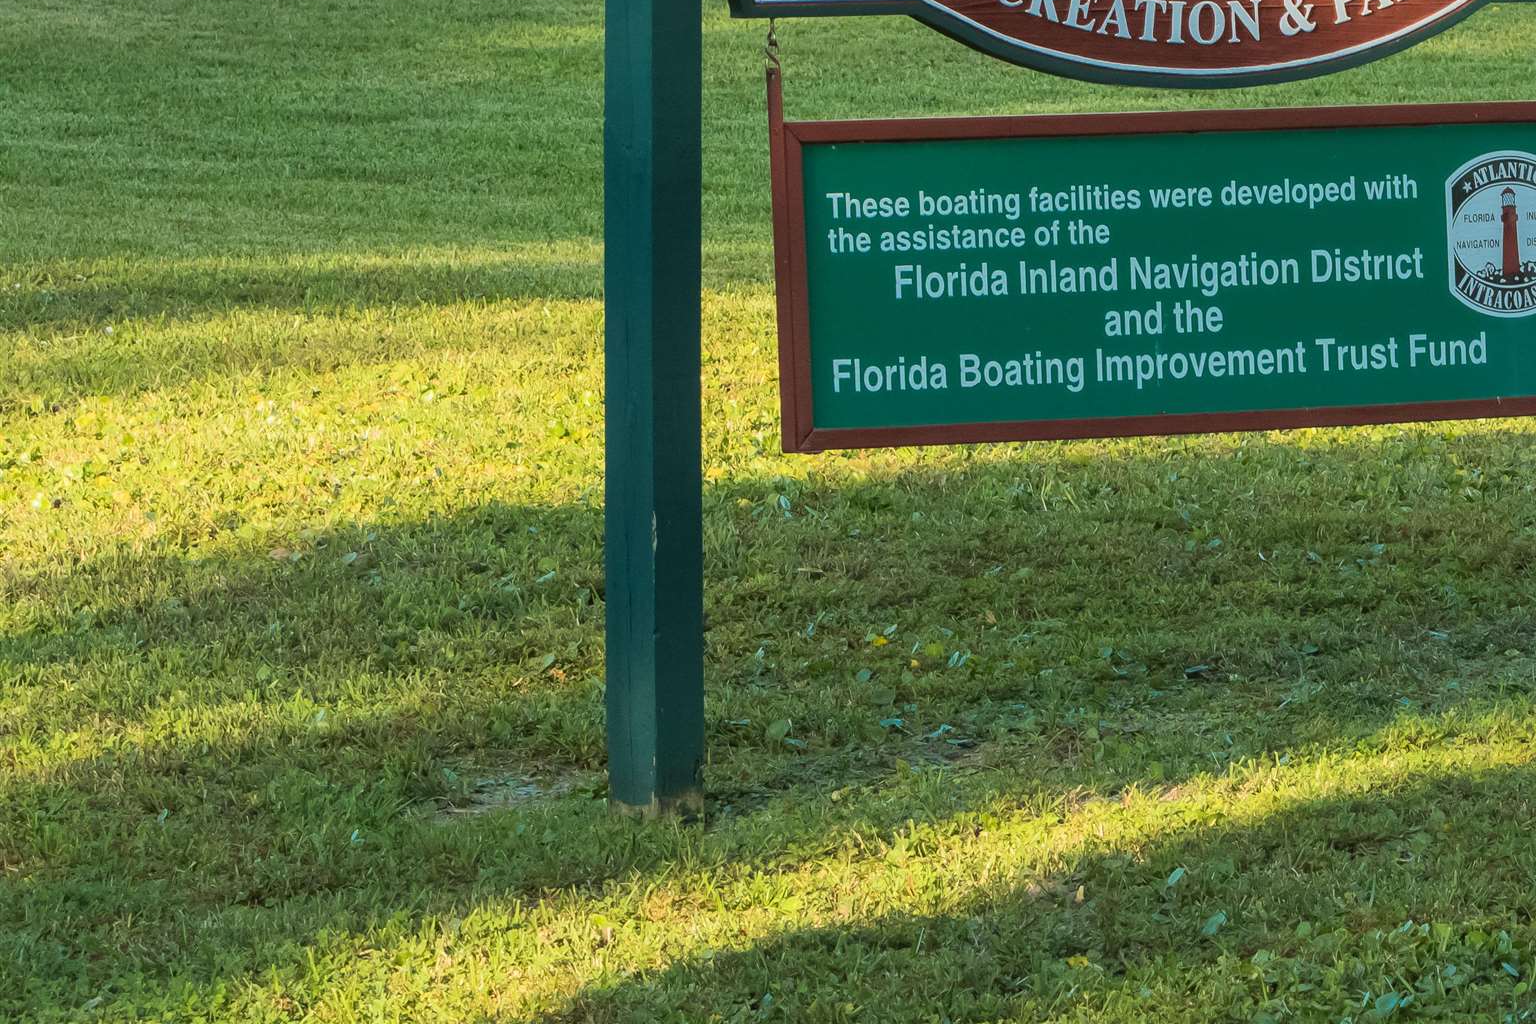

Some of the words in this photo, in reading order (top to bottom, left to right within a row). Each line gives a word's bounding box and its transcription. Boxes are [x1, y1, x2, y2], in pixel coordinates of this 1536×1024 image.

[826, 192, 910, 219] These
[918, 188, 1021, 220] boating
[1028, 184, 1142, 213] facilities
[1149, 186, 1213, 209] were
[1220, 176, 1356, 209] developed
[1363, 174, 1418, 201] with
[828, 227, 871, 254] the
[880, 224, 1026, 252] assistance
[1034, 220, 1060, 246] of
[1068, 219, 1110, 245] the
[1463, 212, 1496, 224] FLORIDA
[1456, 239, 1500, 250] NAVIGATION
[894, 262, 1009, 299] Florida
[1019, 257, 1118, 295] Inland
[1129, 251, 1299, 297] Navigation
[1310, 247, 1424, 283] District
[1104, 301, 1163, 337] and
[1173, 299, 1224, 333] the
[832, 355, 948, 393] Florida
[959, 350, 1086, 393] Boating
[1096, 341, 1307, 389] Improvement
[1315, 335, 1399, 372] Trust
[1409, 330, 1488, 368] Fund
